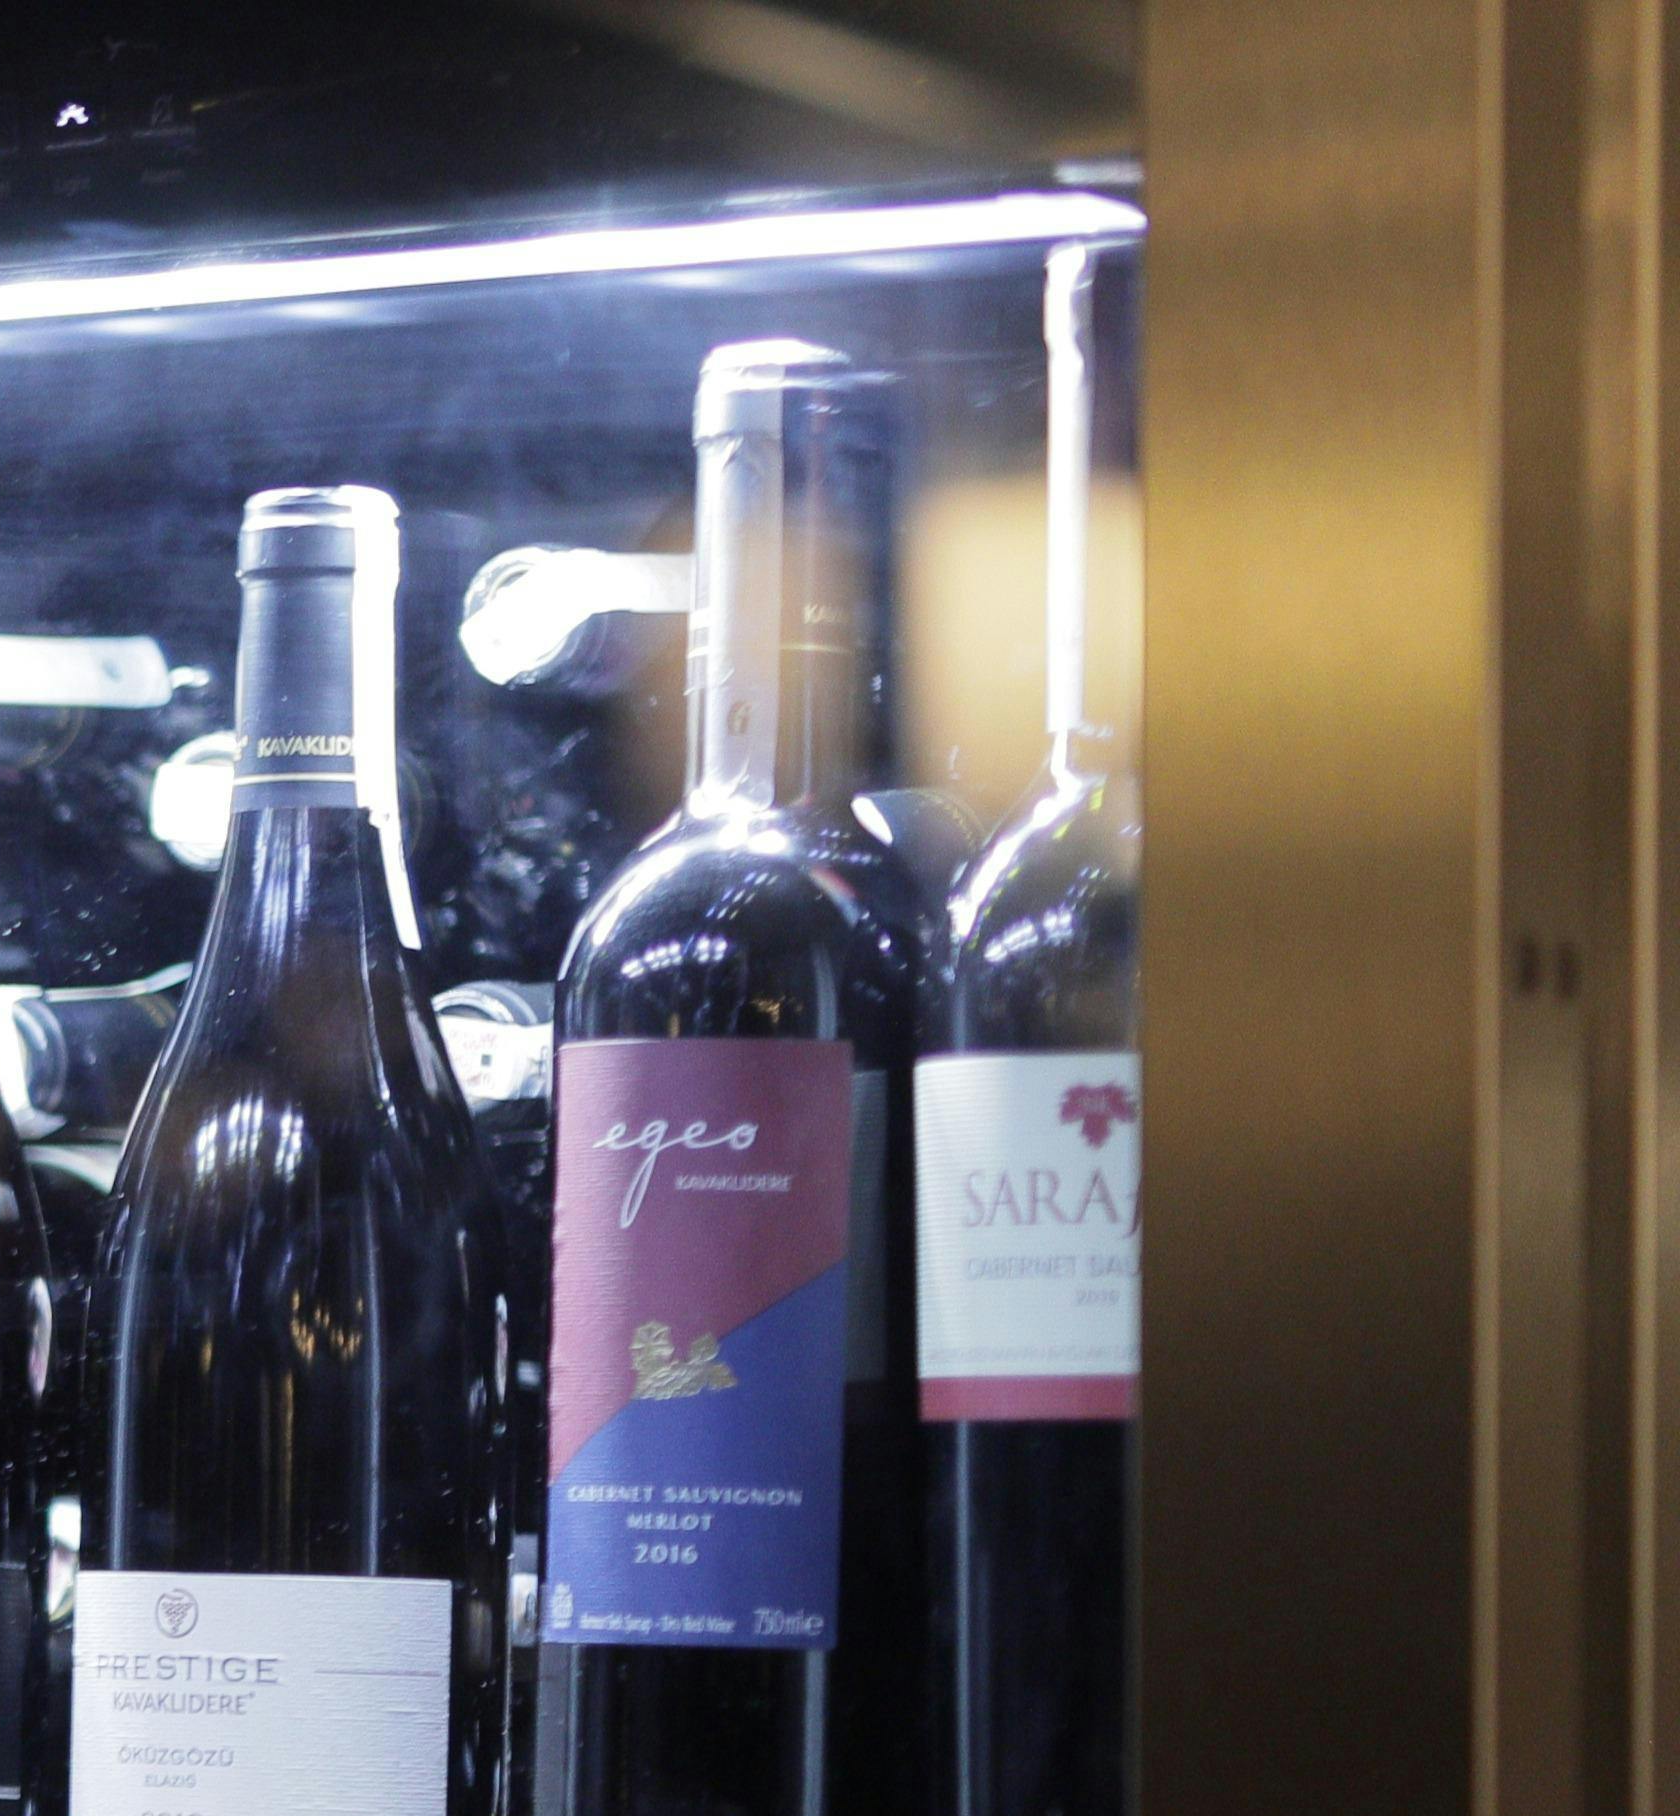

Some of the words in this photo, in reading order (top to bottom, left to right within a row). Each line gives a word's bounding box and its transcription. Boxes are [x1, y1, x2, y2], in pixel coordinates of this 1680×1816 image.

[592, 1118, 760, 1229] egeo
[663, 1486, 803, 1506] SAUVIGNON
[626, 1513, 715, 1531] MERLOT
[633, 1543, 699, 1565] 2016
[96, 1653, 280, 1685] PRESTIGE
[112, 1691, 249, 1716] KAVAKLIDERE
